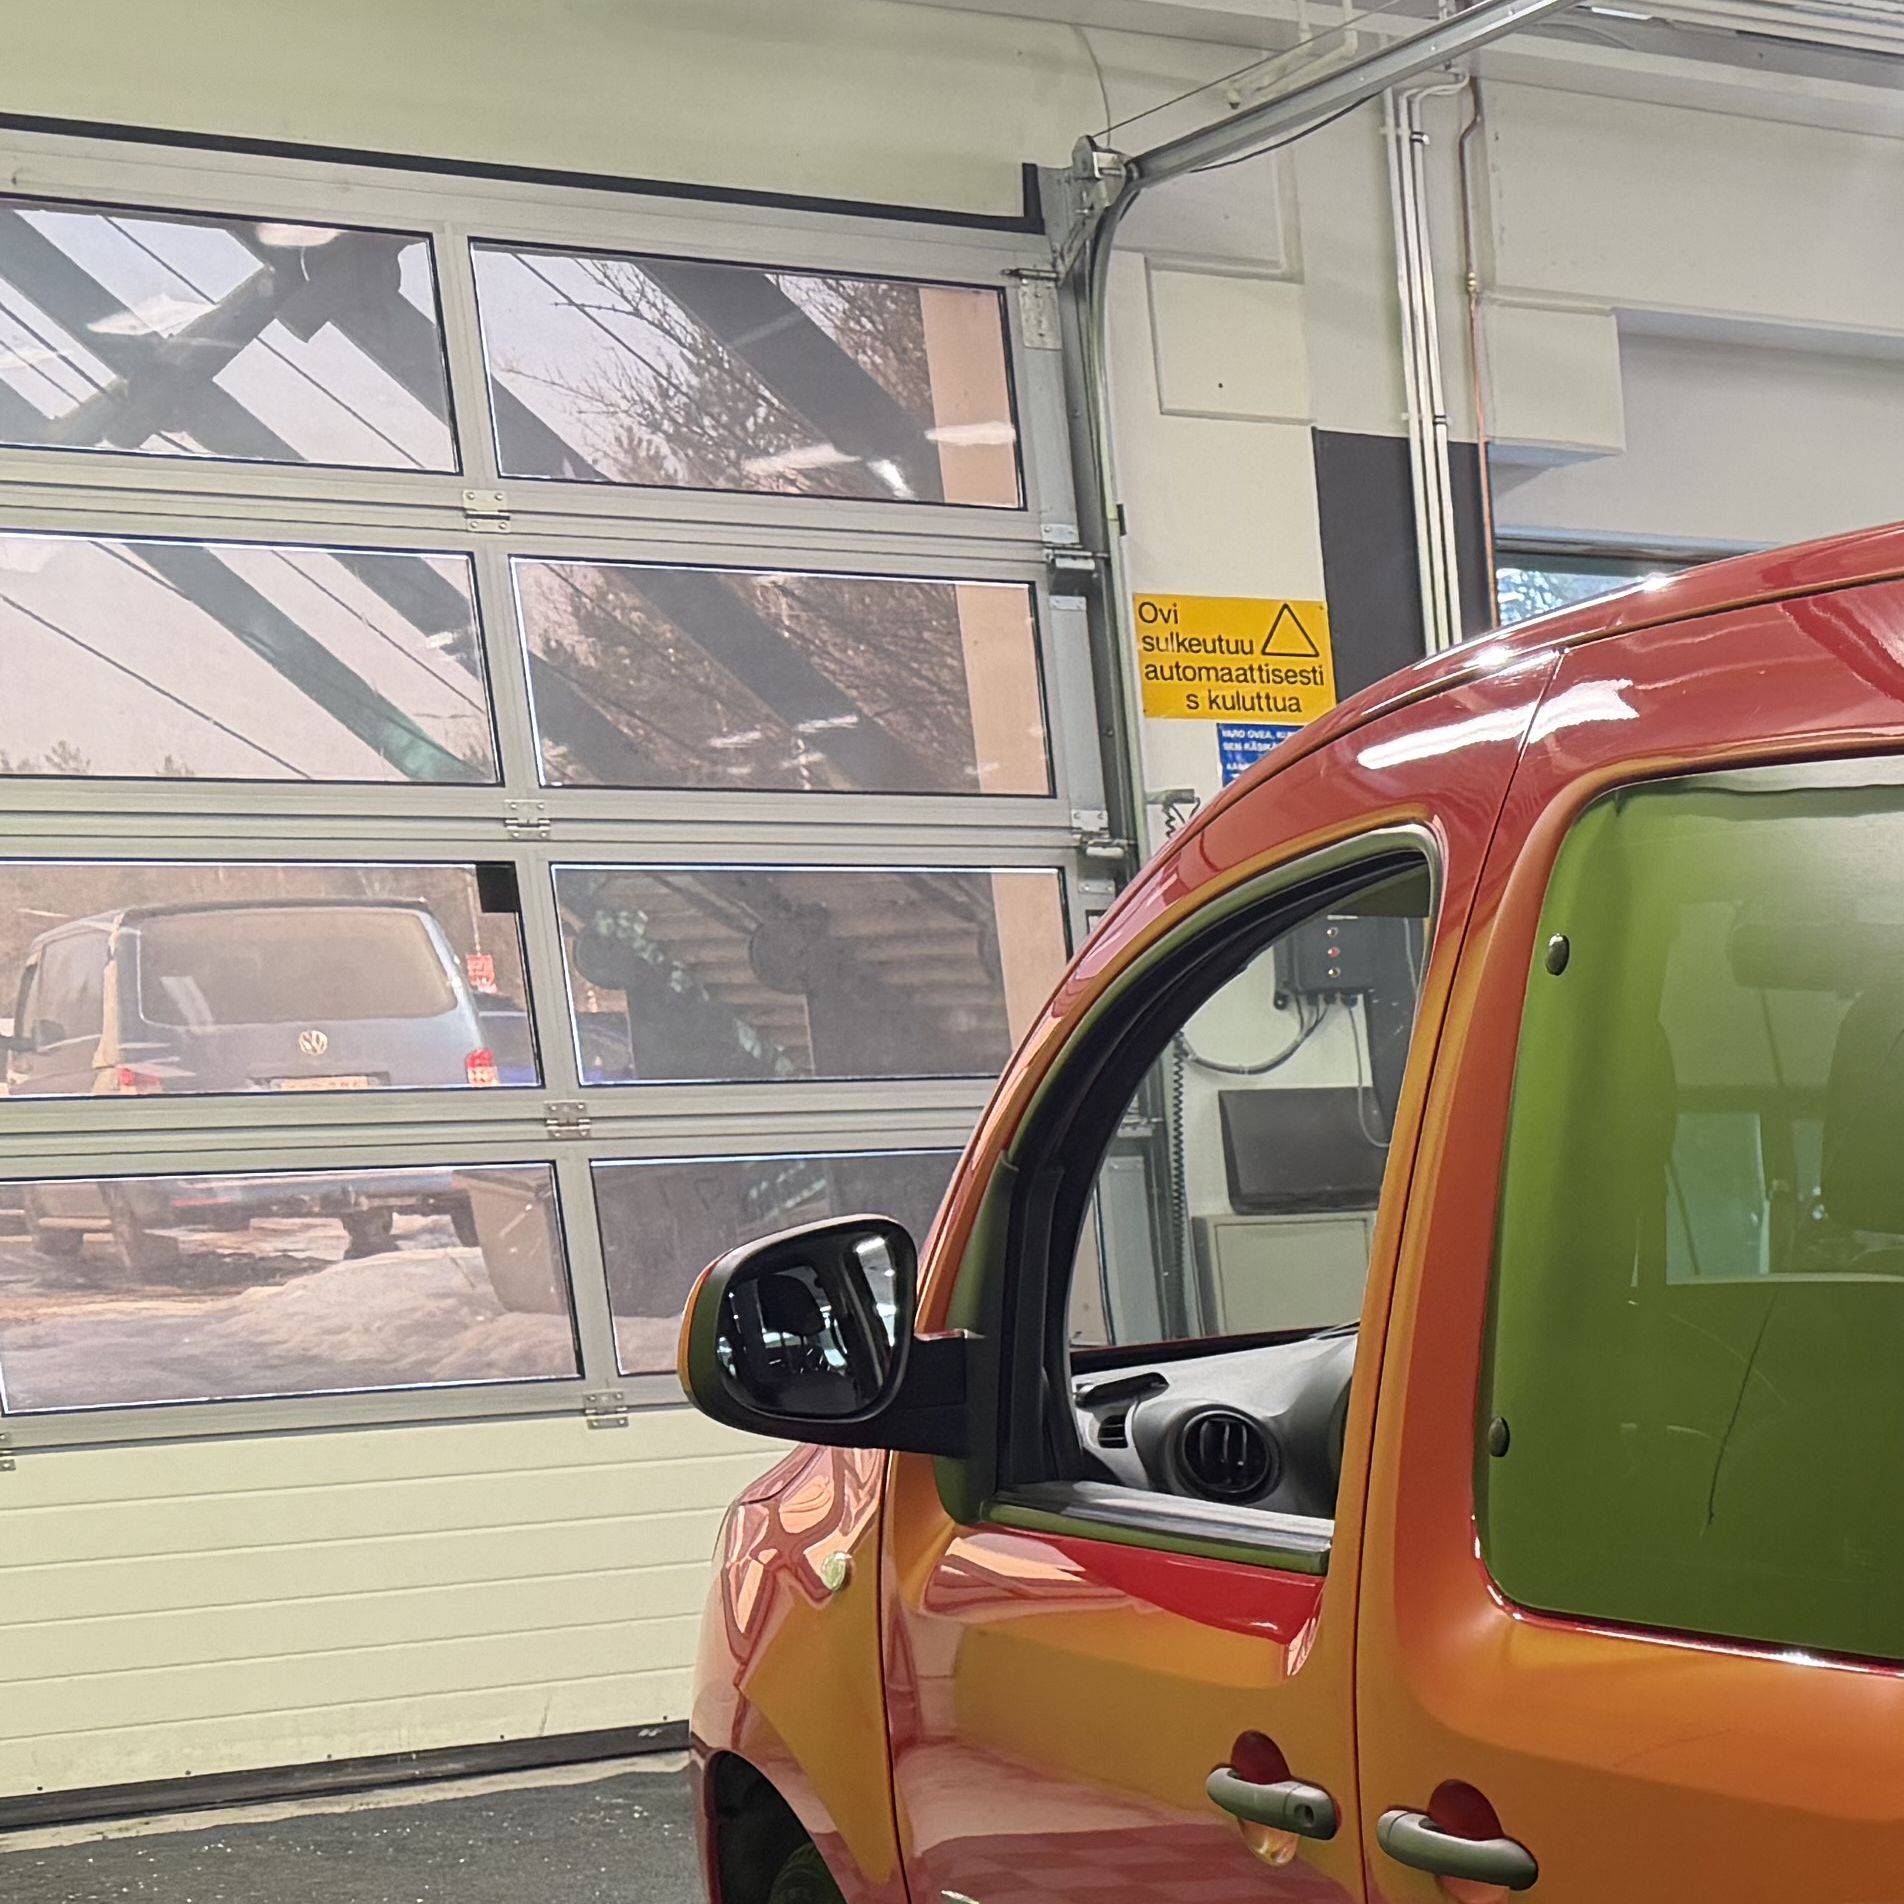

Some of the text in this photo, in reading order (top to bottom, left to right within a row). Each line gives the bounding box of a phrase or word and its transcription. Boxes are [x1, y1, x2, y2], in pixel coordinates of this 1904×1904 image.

[1138, 601, 1179, 625] Ovi
[1141, 632, 1255, 656] sulkeutuu
[1144, 661, 1325, 687] automaattisesti
[1186, 688, 1303, 713] s kuluttua
